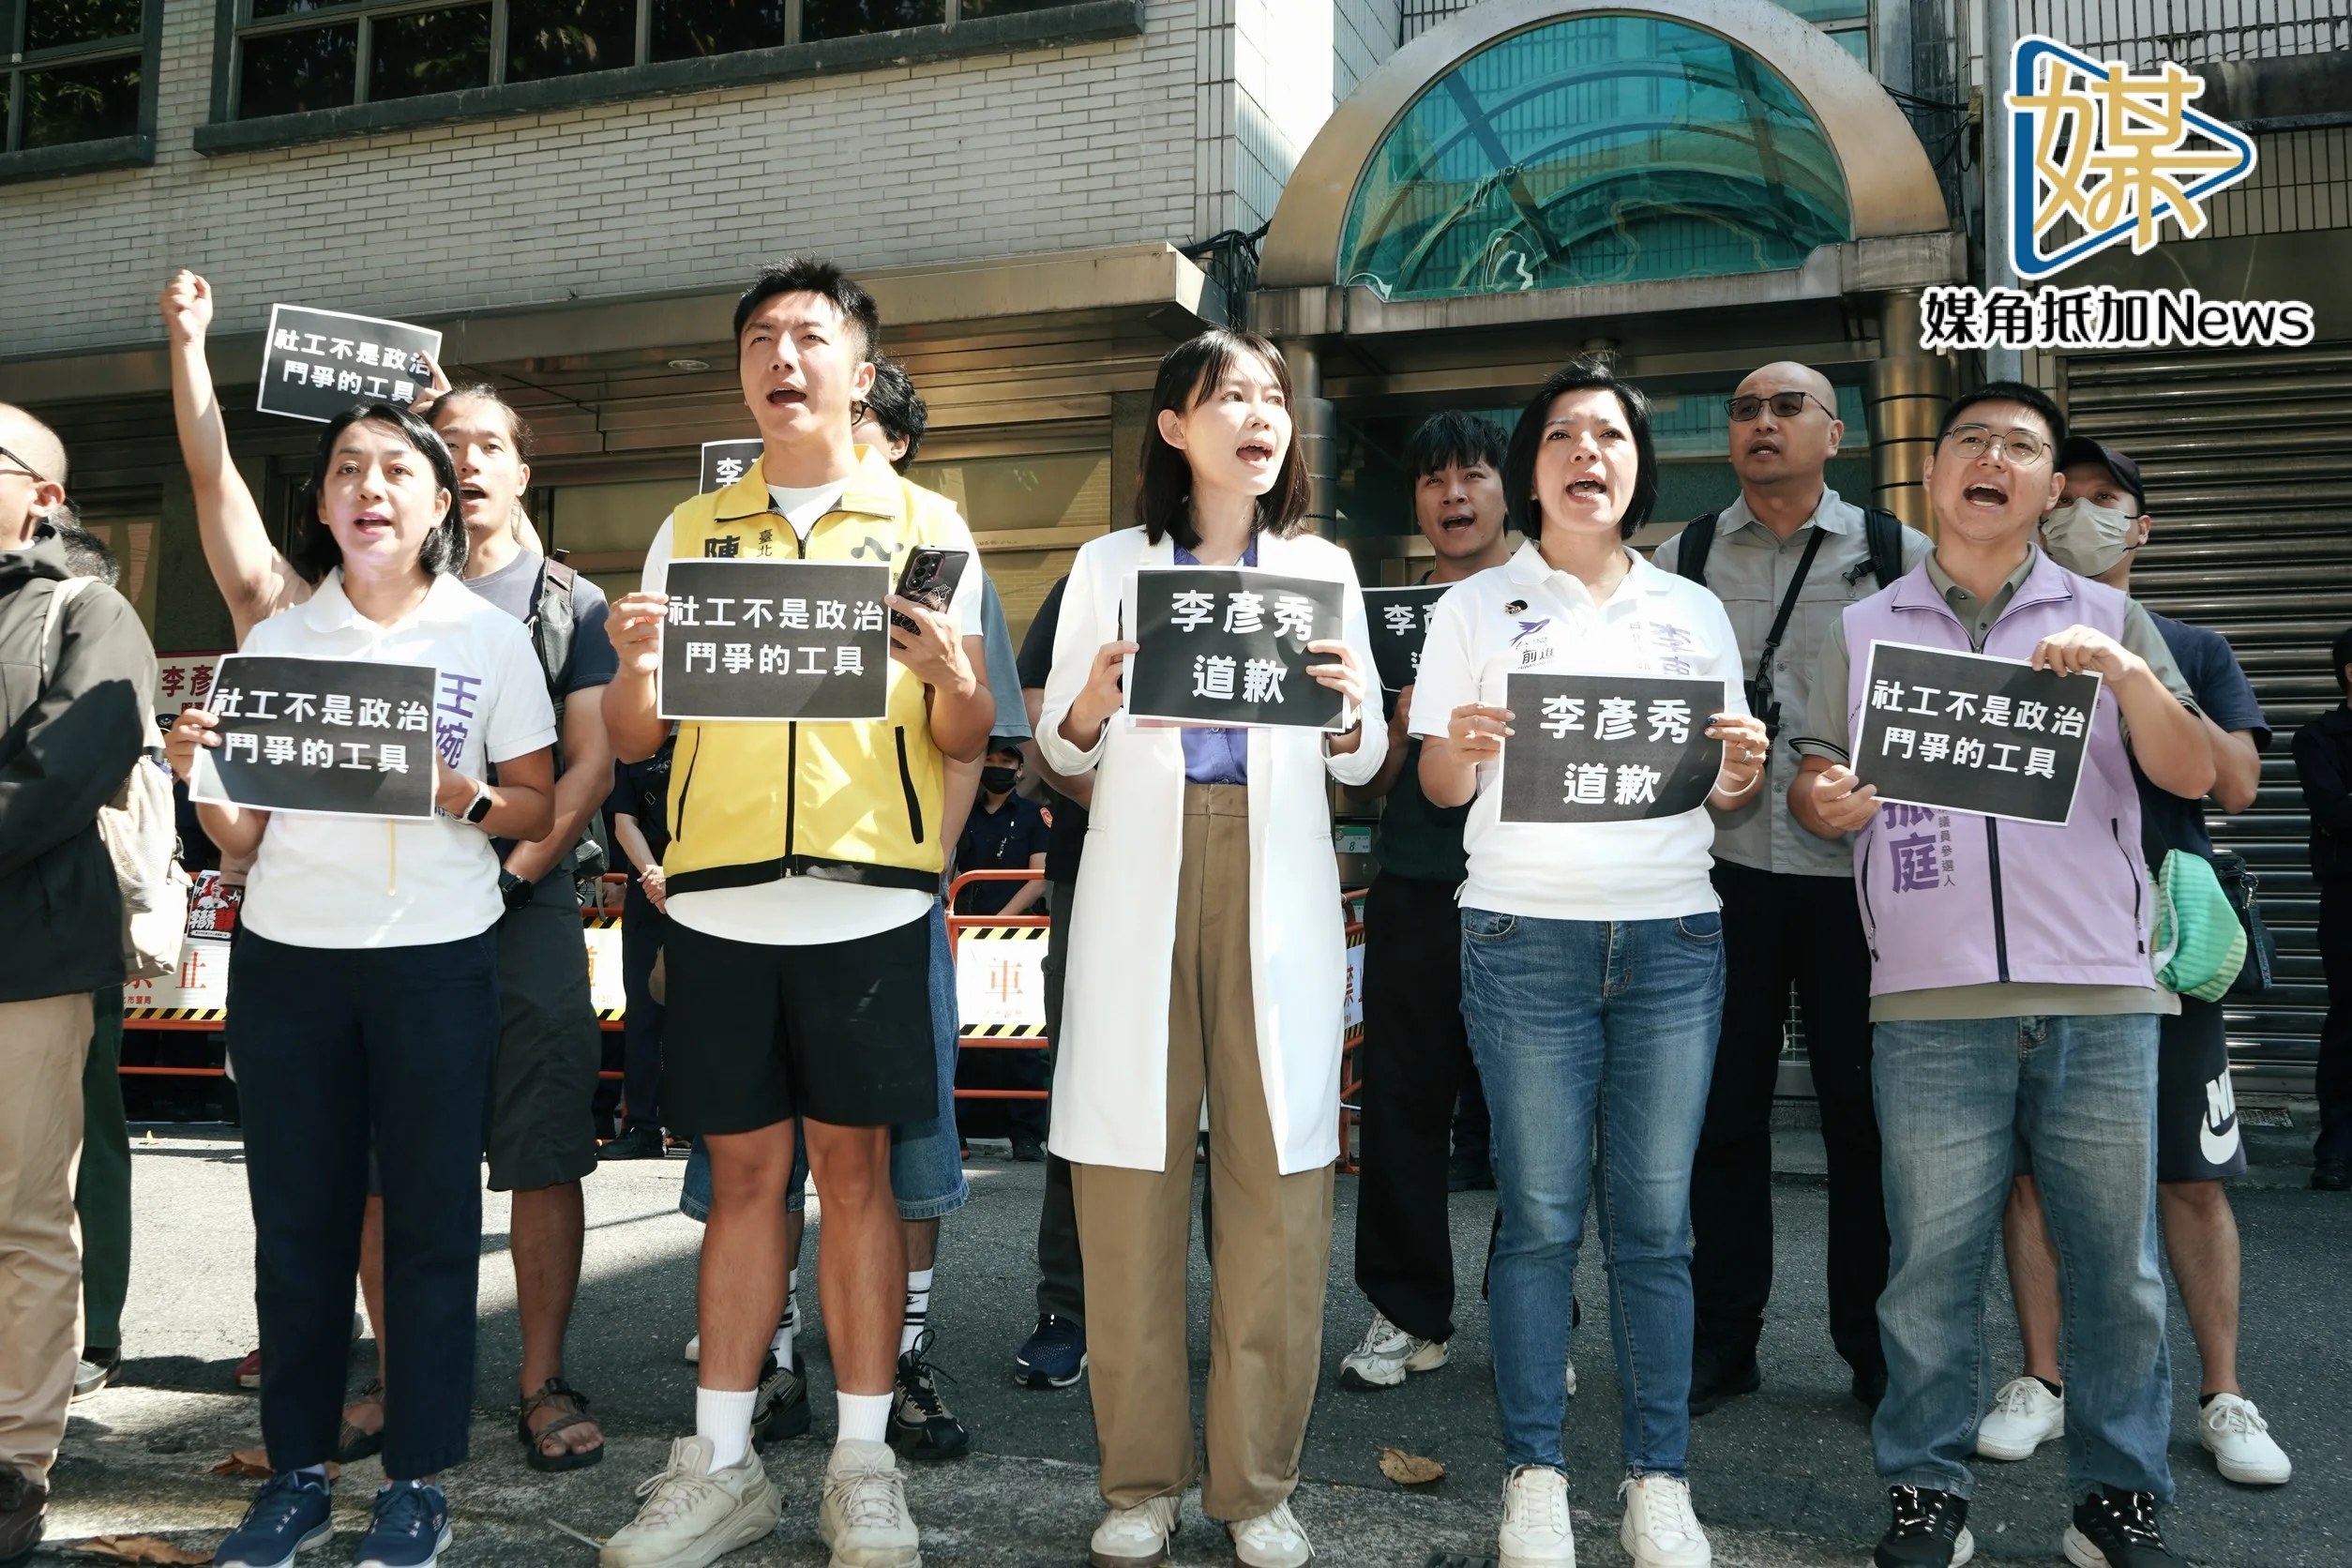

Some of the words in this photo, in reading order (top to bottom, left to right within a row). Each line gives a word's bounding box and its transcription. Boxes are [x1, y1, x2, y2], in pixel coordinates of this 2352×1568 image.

[274, 328, 430, 376] 社工不是政治
[283, 359, 415, 404] 鬥爭的工具
[716, 457, 759, 488] 李
[668, 594, 884, 632] 社工不是政治
[1171, 589, 1314, 641] 李彥秀
[686, 641, 865, 676] 鬥爭的工具
[1192, 654, 1288, 704] 道歉
[209, 687, 430, 732] 社工不是政治
[1540, 694, 1692, 744] 李彥秀
[1871, 679, 2087, 739] 社工不是政治
[225, 731, 410, 774] 鬥爭的工具
[1881, 726, 2058, 780] 鬥爭的工具
[1562, 761, 1662, 806] 道歉
[1937, 809, 1955, 887] 議員參選人
[123, 996, 152, 1005] 市警局
